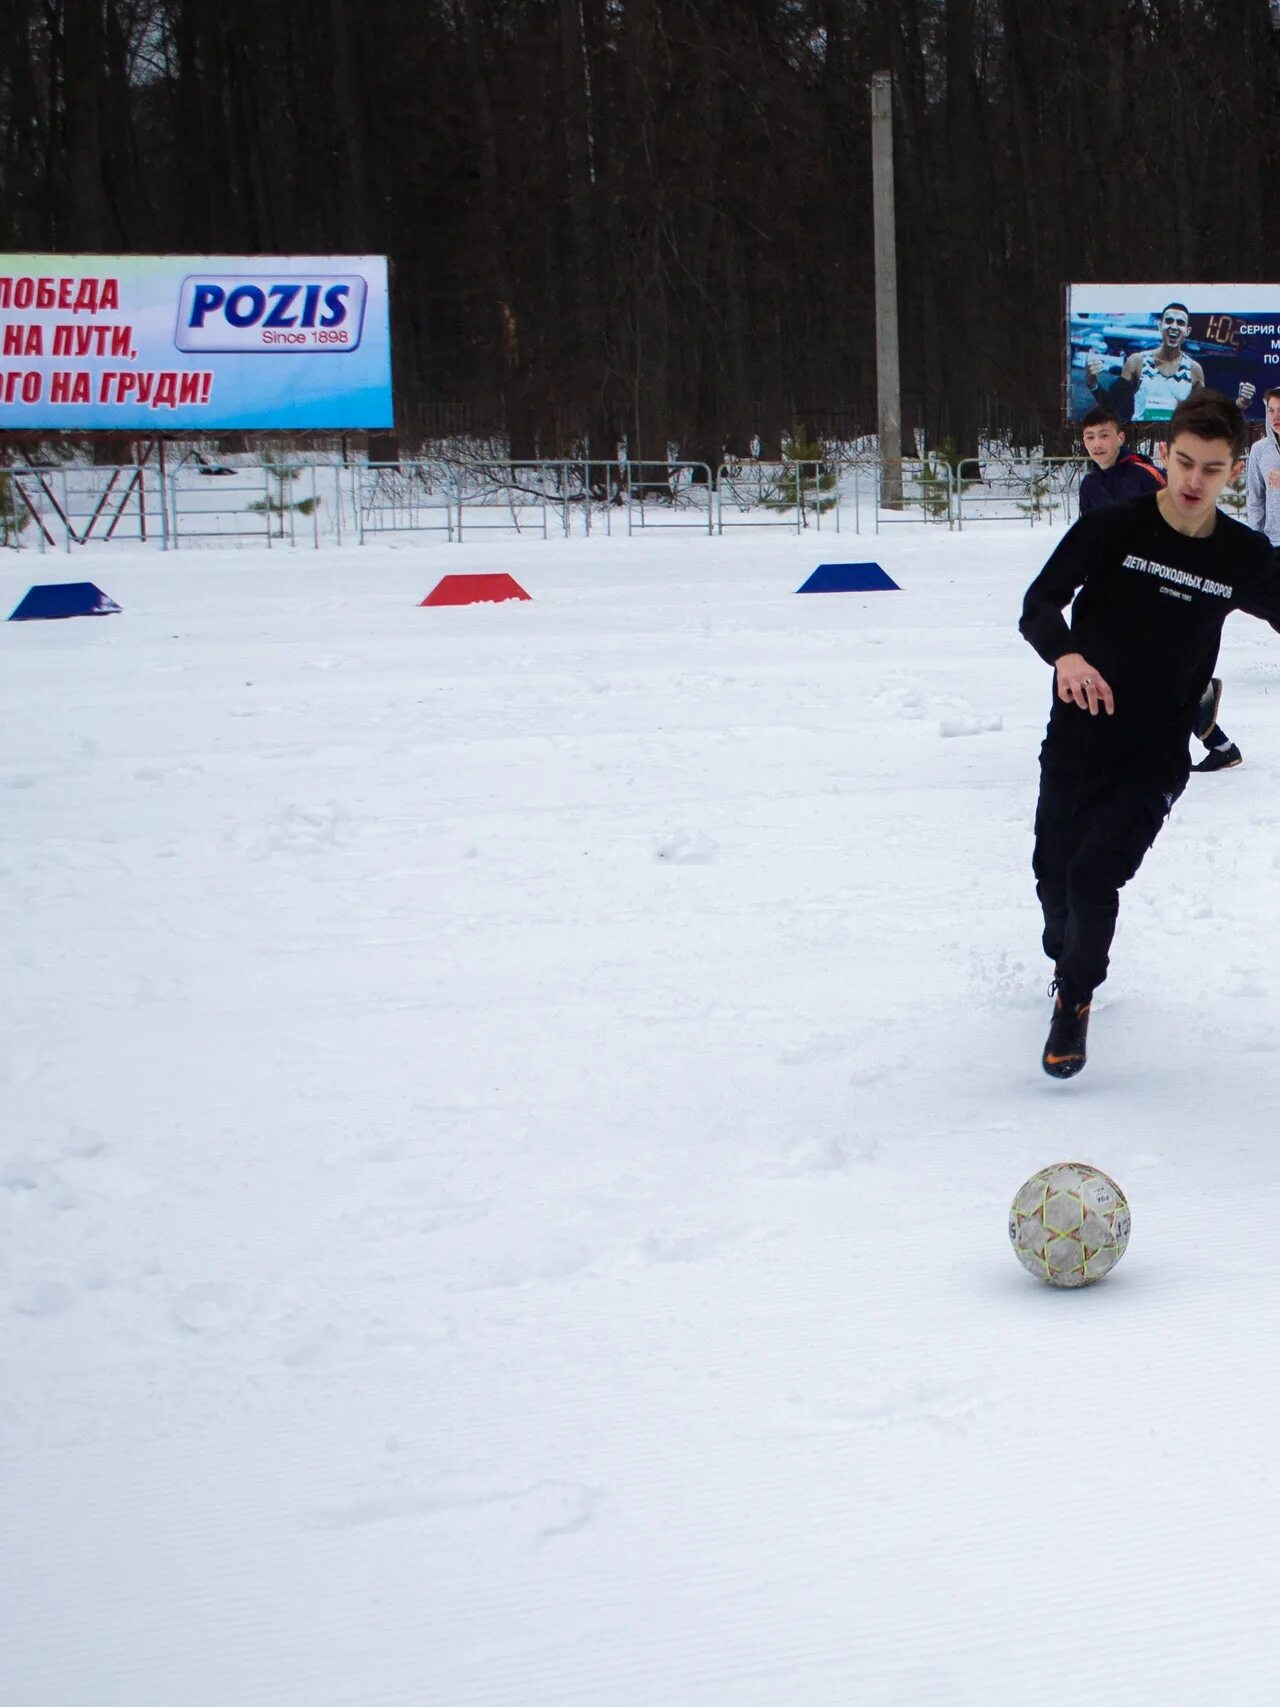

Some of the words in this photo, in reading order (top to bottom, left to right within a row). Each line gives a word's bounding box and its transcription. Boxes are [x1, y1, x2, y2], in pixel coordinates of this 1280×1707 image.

[188, 284, 351, 328] POZIS
[3, 324, 44, 357] НА
[52, 324, 138, 360] ПУТИ,
[262, 330, 306, 345] Since
[311, 330, 349, 344] 1898
[1239, 324, 1275, 336] СЕРИЯ
[1263, 354, 1280, 365] ПО
[0, 371, 43, 404] ГО
[50, 371, 92, 404] НА
[99, 371, 214, 409] ГРУДИ!
[1121, 555, 1148, 573] ДЕТИ
[1147, 561, 1203, 589] ПРОХОДНЫХ
[1201, 579, 1233, 599] ДВОРОВ
